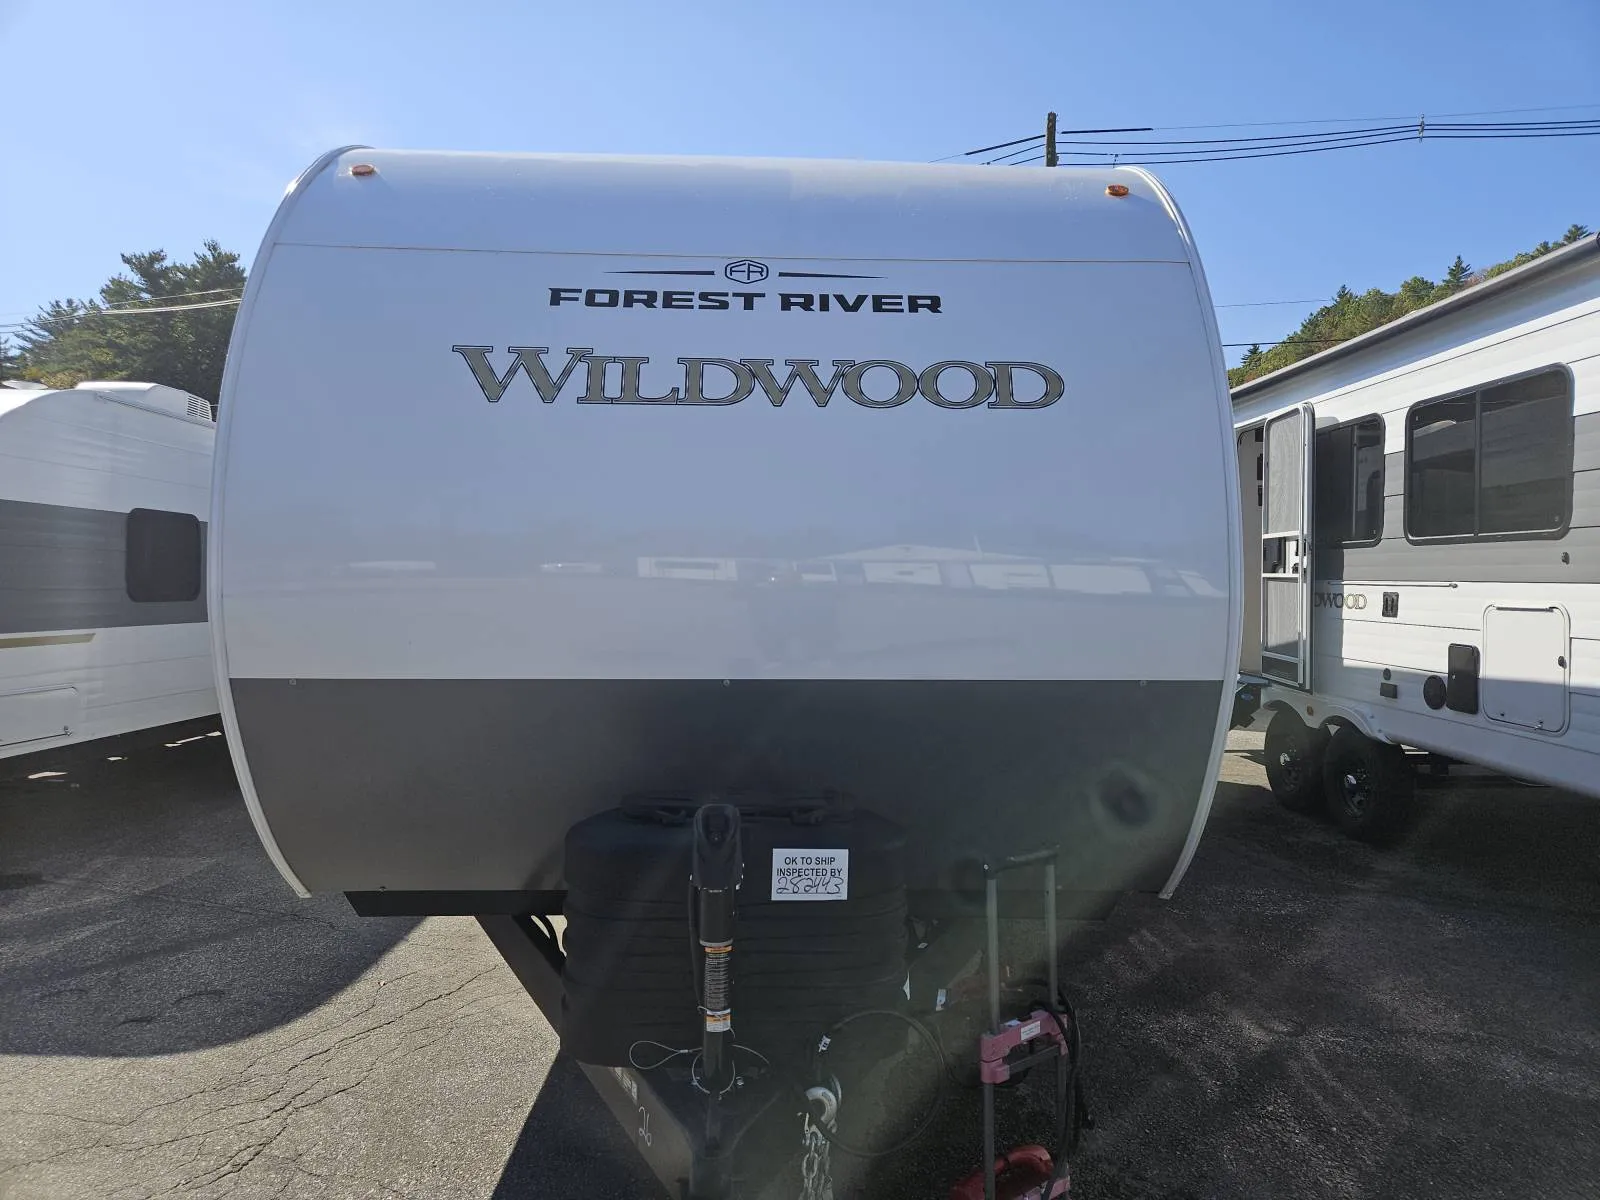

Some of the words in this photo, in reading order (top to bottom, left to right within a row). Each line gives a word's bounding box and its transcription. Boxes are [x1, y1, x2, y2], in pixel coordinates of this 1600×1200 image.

[729, 261, 765, 281] FR
[549, 287, 766, 311] FOREST
[777, 292, 943, 314] RIVER
[453, 345, 1064, 409] WILDWOOD
[784, 856, 798, 865] OK
[800, 856, 813, 865] TO
[814, 856, 836, 866] SHIP
[776, 868, 828, 877] INSPECTED
[830, 868, 843, 877] BY
